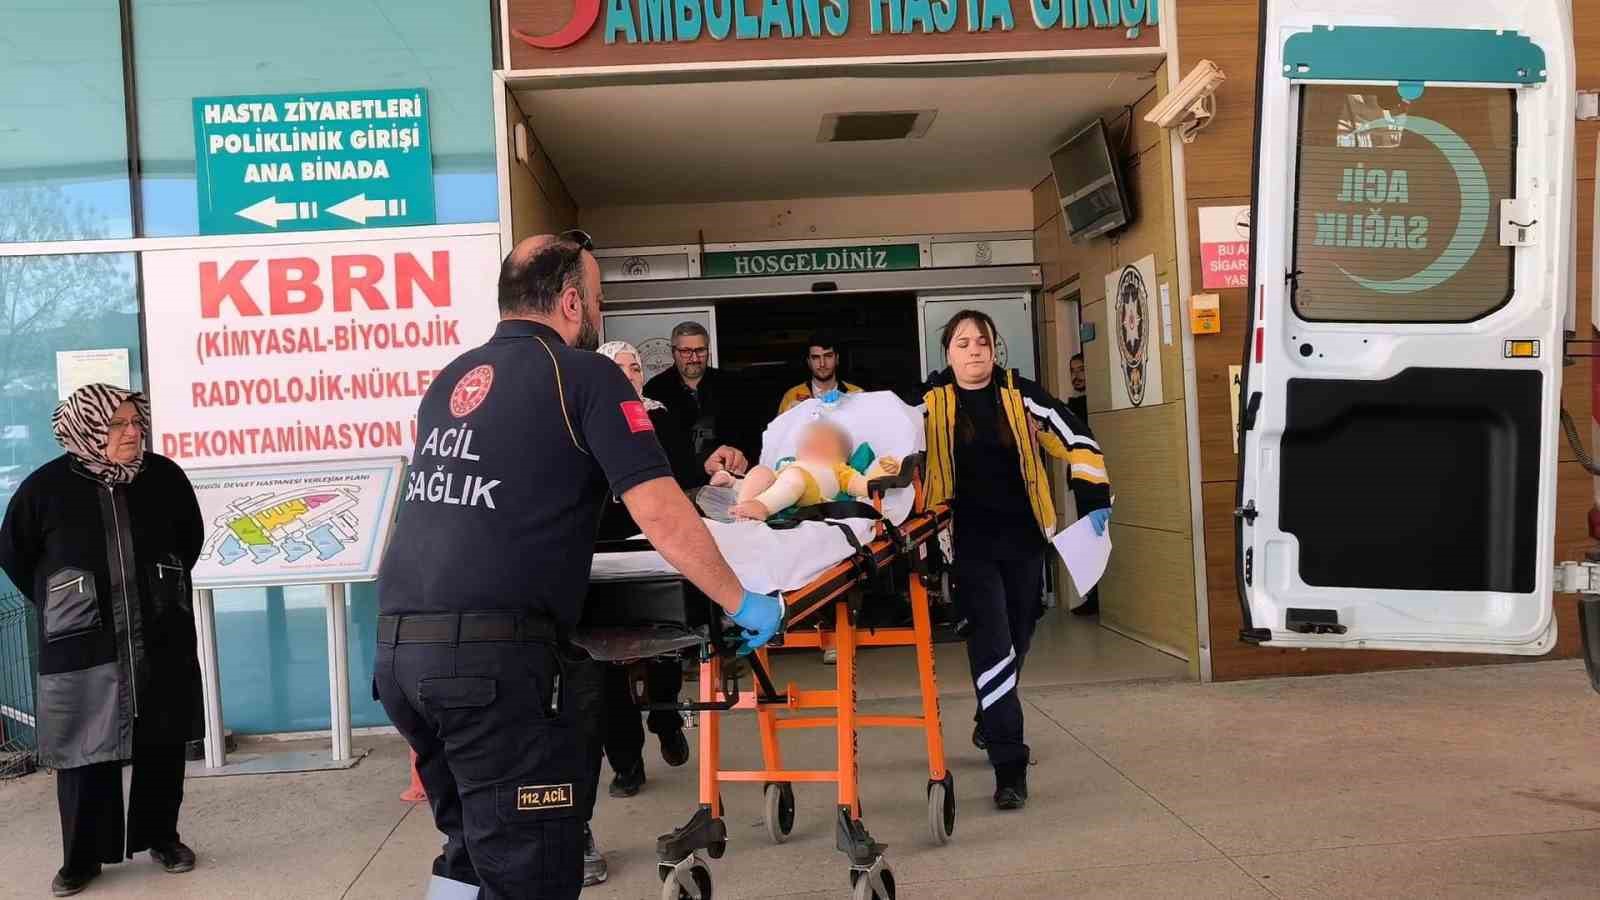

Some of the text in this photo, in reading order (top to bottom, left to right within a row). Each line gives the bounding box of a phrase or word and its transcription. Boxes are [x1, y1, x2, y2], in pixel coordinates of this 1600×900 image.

[204, 93, 422, 124] HASTA ZİYARETLERİ
[209, 122, 420, 154] POLİKLİNİK GİRİŞİ
[243, 155, 390, 183] ANA BİNADA
[1217, 244, 1234, 256] BU
[199, 250, 452, 319] KBRN
[196, 313, 461, 365] (KİMYASAL-BİYOLOJİK
[191, 367, 442, 408] RADYOLOJİK-NÜKLE
[161, 419, 402, 459] DEKONTAMİNASYON
[420, 422, 481, 462] ACİL
[405, 464, 502, 510] SAĞLIK
[521, 788, 567, 805] 112 ACİL
